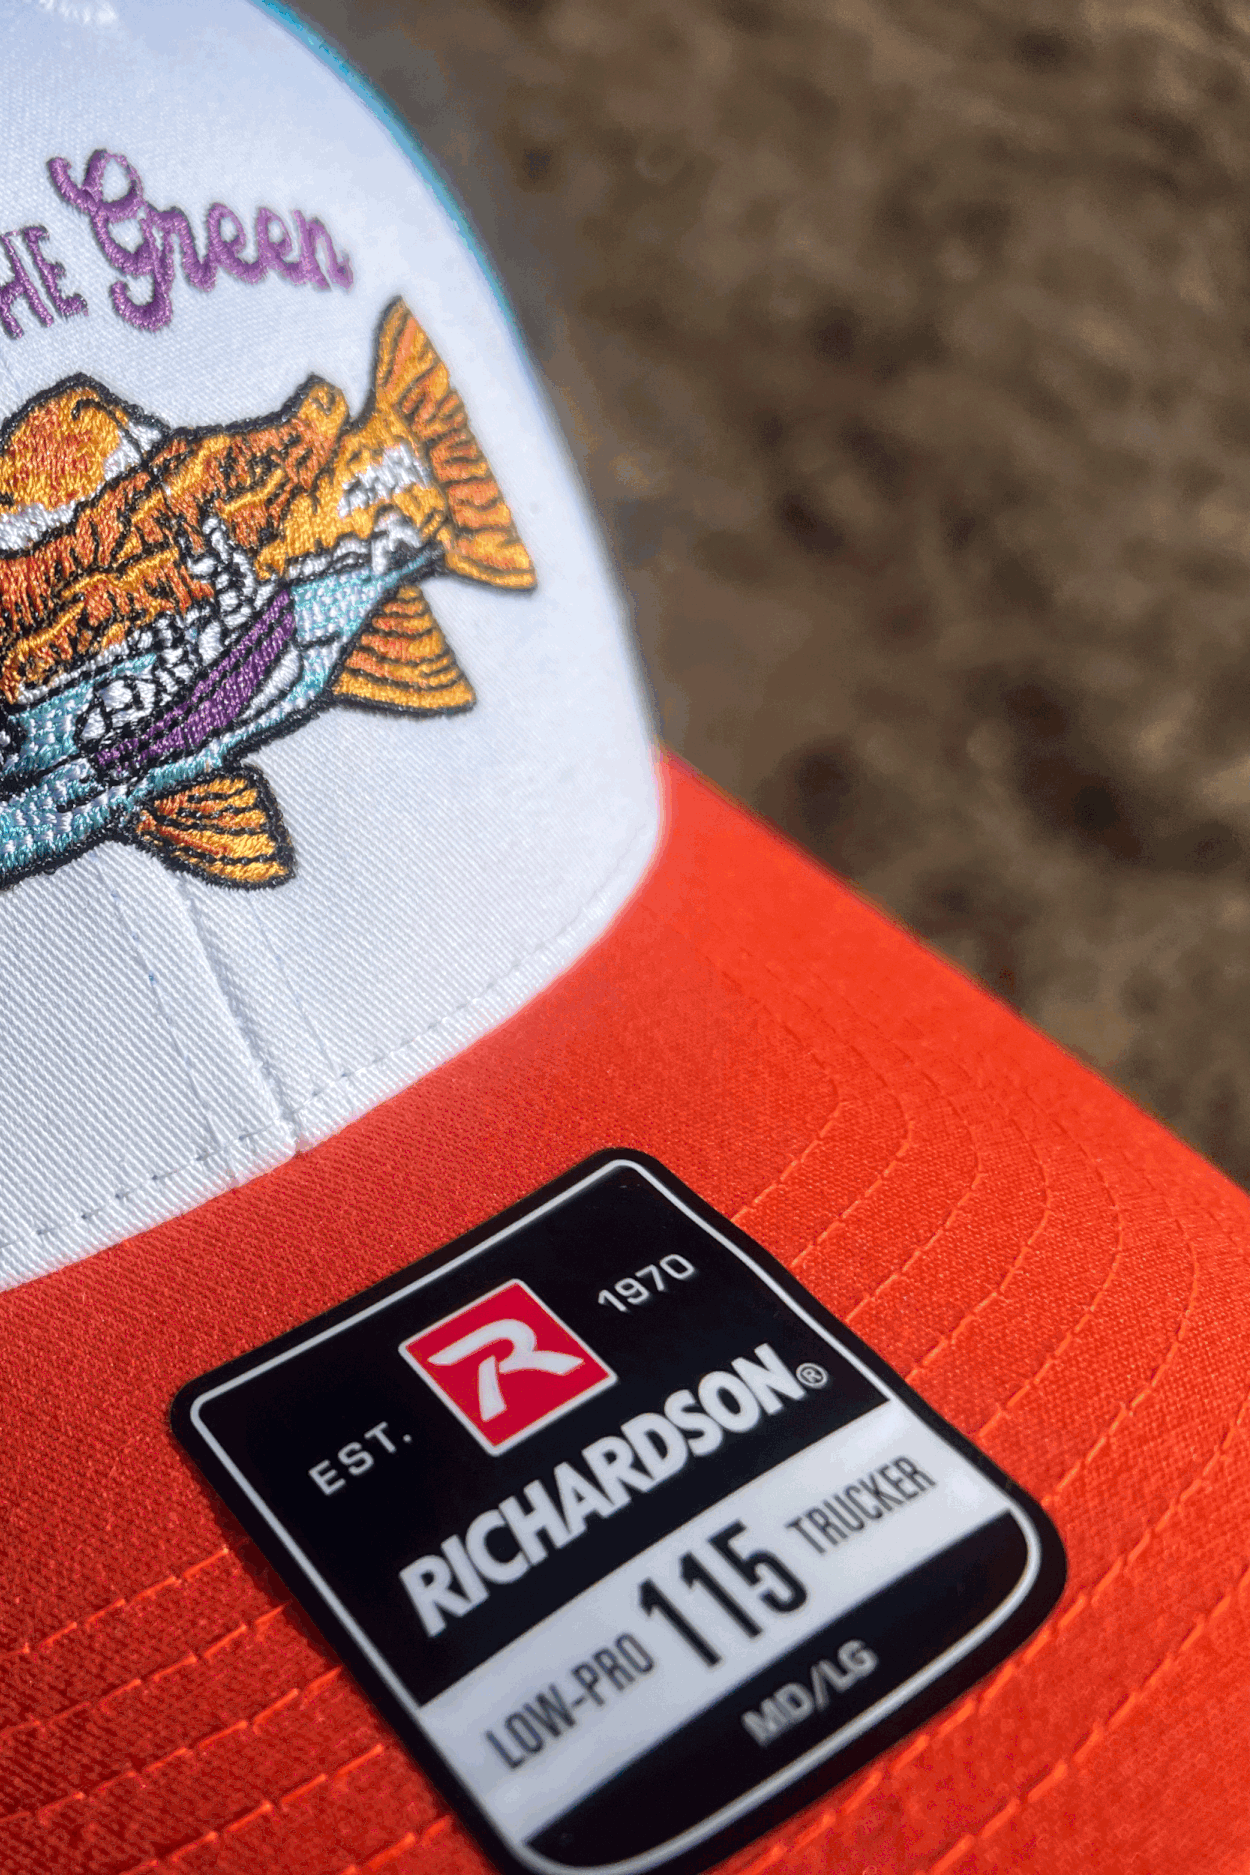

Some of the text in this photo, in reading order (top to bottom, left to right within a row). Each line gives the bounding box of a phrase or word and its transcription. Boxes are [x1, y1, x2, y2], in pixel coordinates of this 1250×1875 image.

[47, 147, 352, 331] Green
[596, 1252, 696, 1315] 1970
[309, 1420, 412, 1496] EST.
[485, 1454, 937, 1771] LOW-PRO 115 TRUCKER
[741, 1638, 879, 1746] MD/LG
